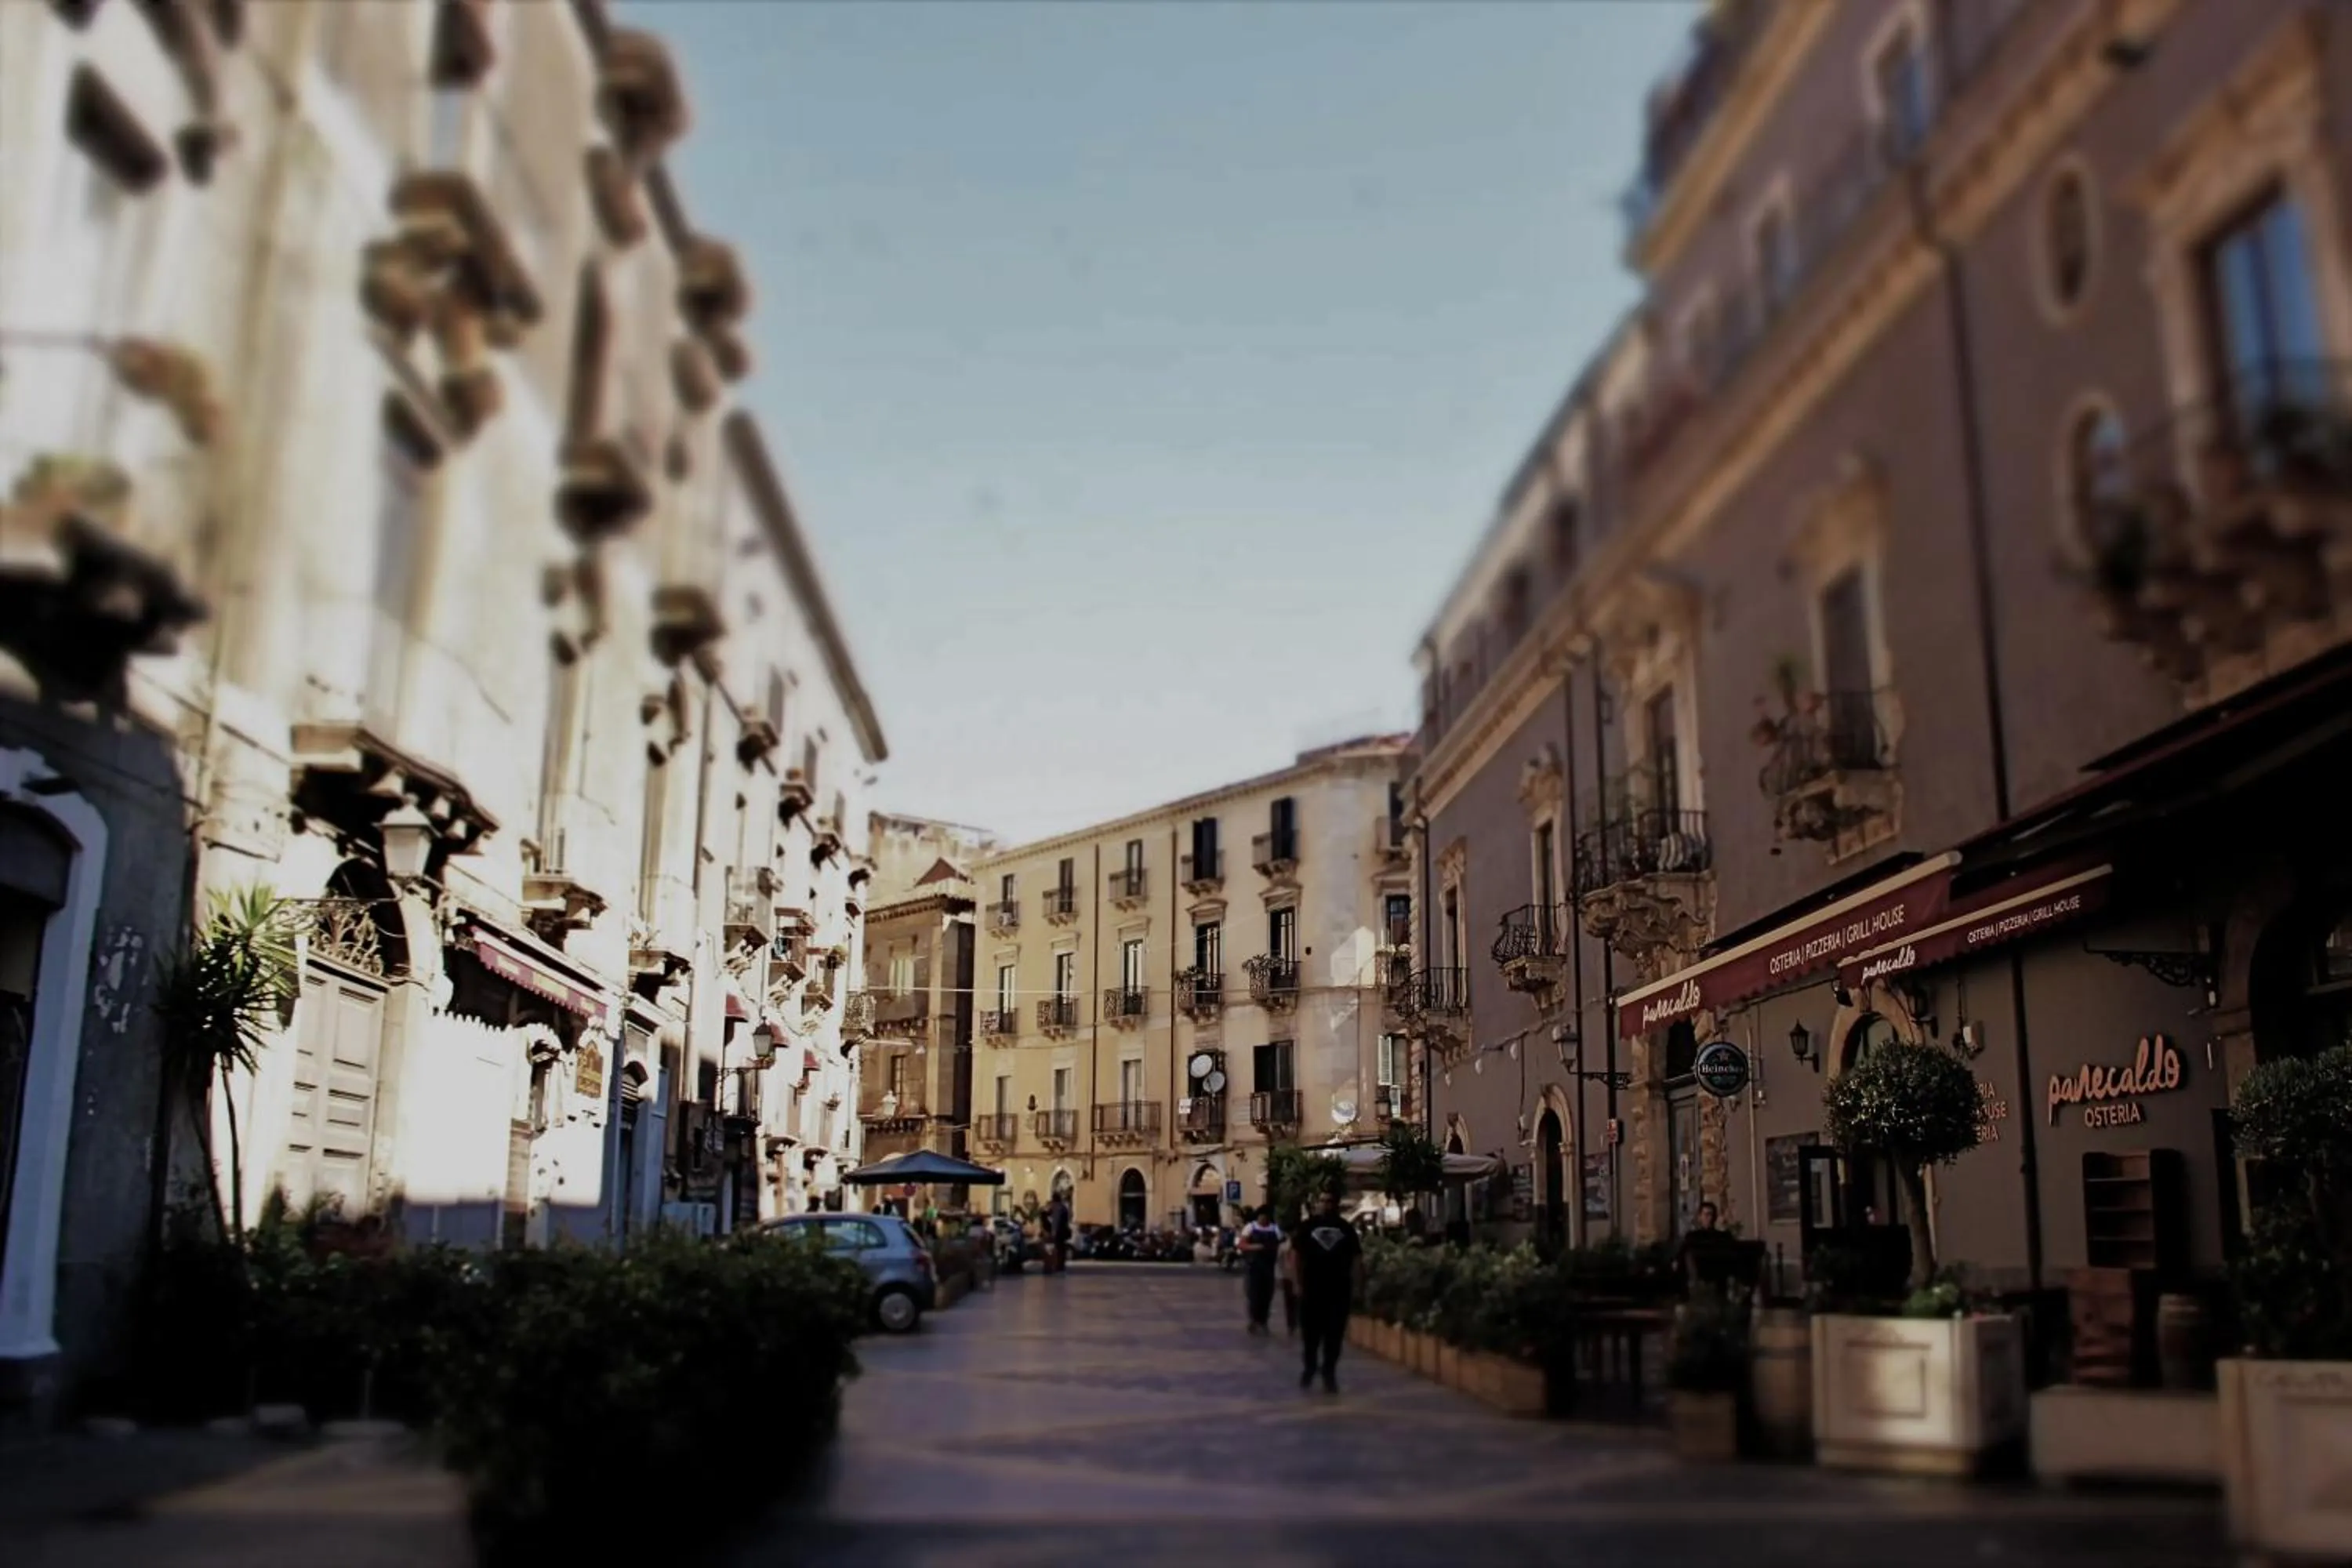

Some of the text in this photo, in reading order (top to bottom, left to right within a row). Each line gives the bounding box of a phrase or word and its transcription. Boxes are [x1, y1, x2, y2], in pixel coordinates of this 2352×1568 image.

[1769, 904, 1904, 974] OSTERIA PIZZERIA GRILL HOUSE
[1967, 895, 2081, 943] OSTERIA PIZZERIA GRILL HOUSE
[1700, 1063, 1744, 1074] Heinek
[2048, 1034, 2180, 1126] panecaldo
[2084, 1102, 2141, 1127] OSTERIA
